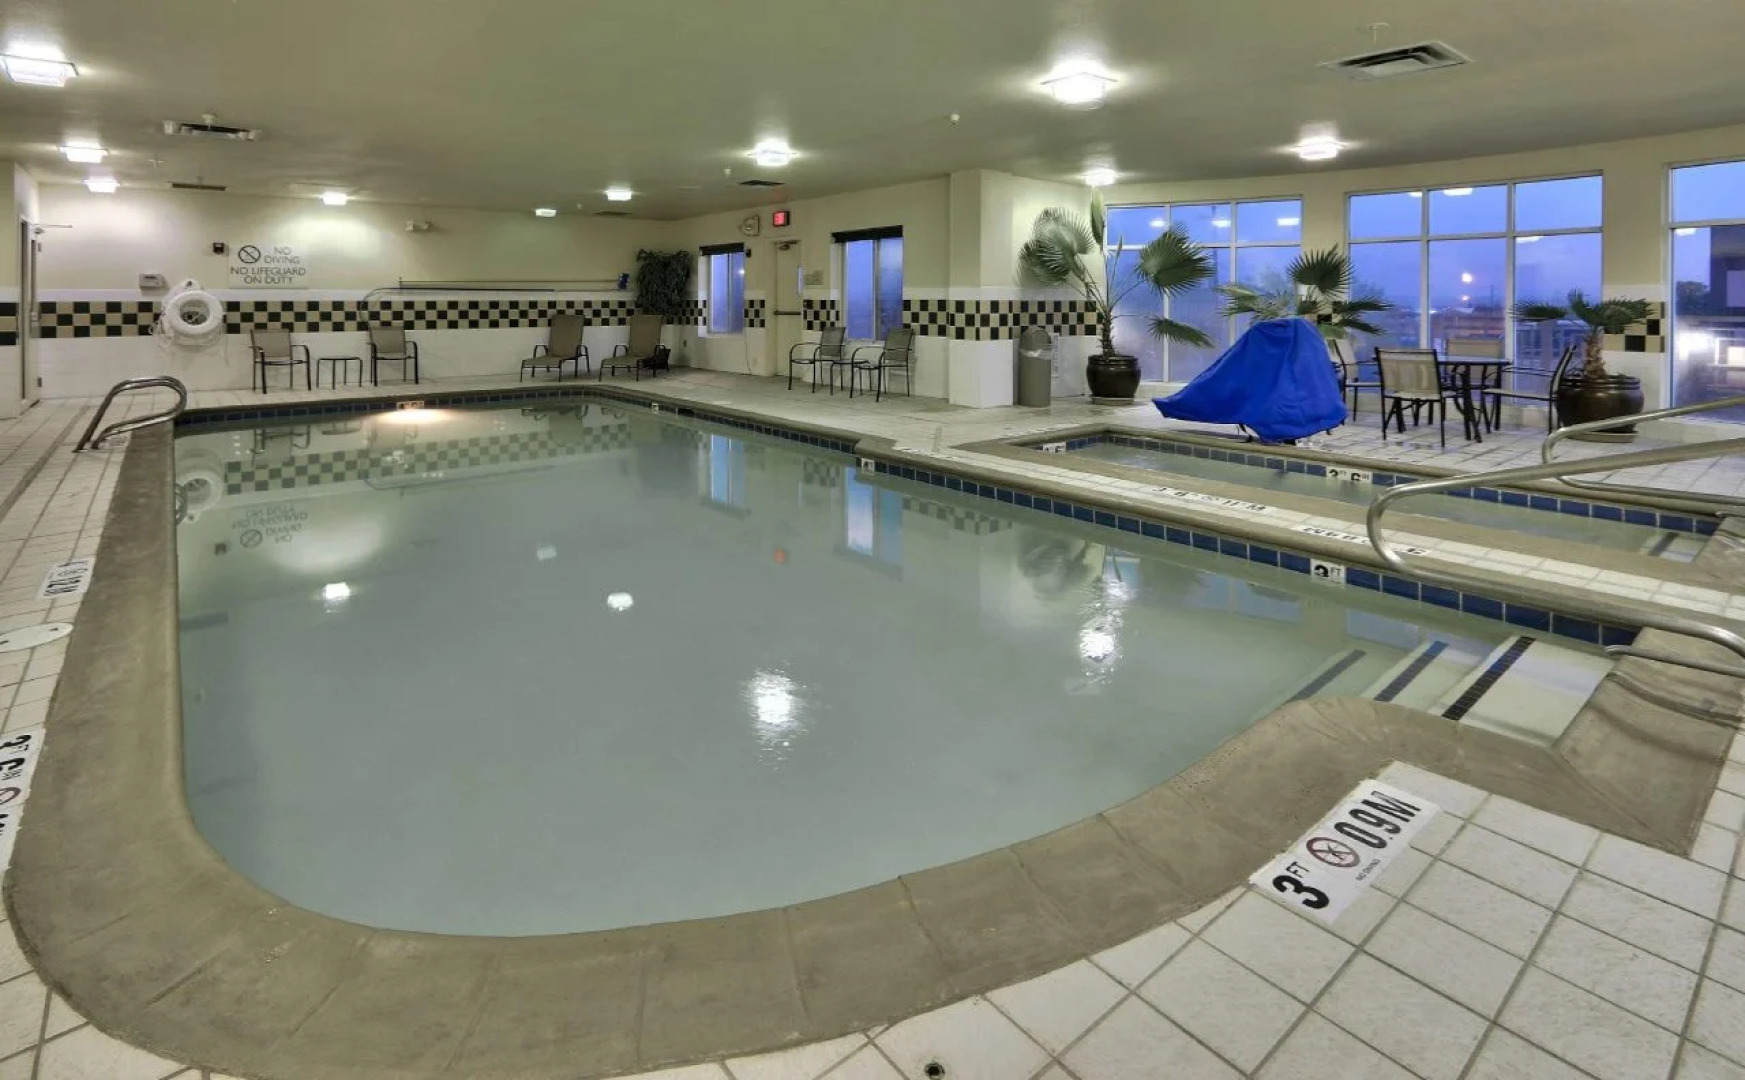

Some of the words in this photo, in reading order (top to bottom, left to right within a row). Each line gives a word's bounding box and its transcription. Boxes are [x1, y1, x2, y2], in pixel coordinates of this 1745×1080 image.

[273, 247, 291, 255] NO
[264, 256, 301, 264] DIVING
[230, 266, 249, 275] NO
[251, 266, 306, 276] LIFEGUARD
[243, 275, 261, 284] ON
[265, 276, 293, 284] DUTY
